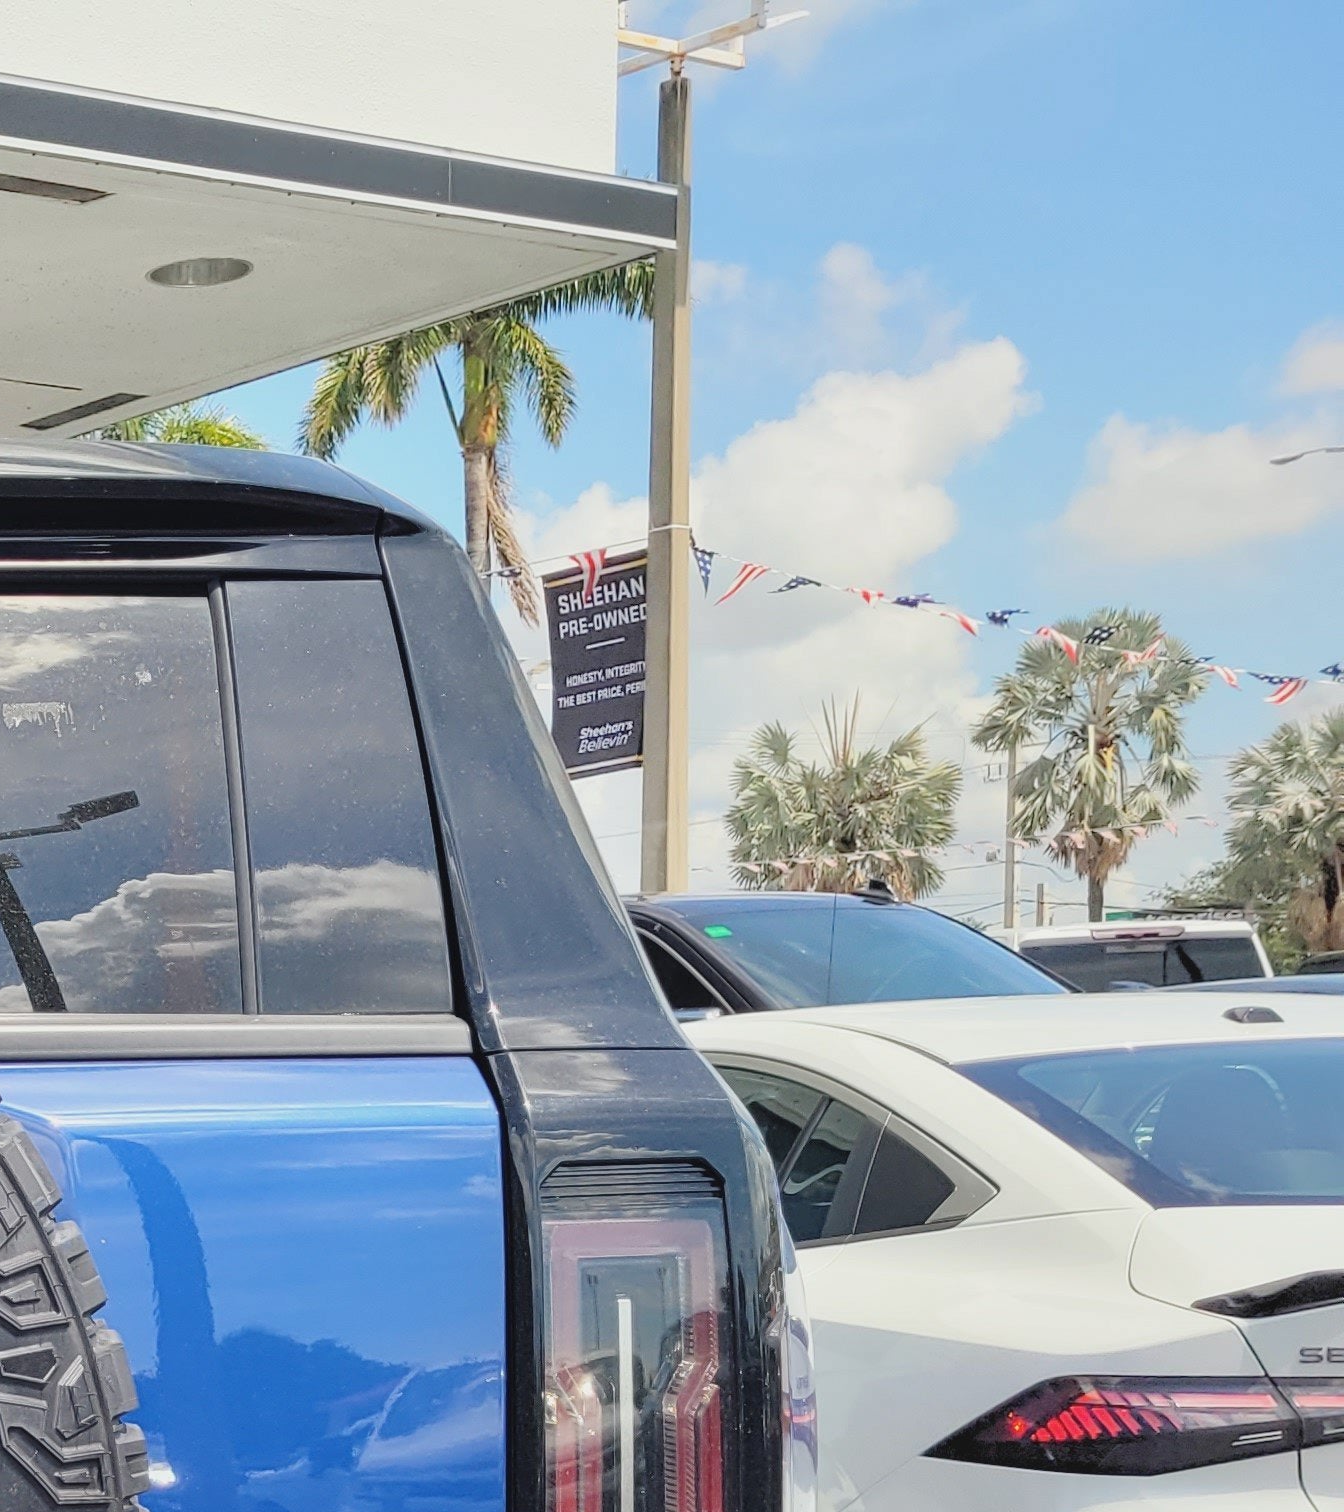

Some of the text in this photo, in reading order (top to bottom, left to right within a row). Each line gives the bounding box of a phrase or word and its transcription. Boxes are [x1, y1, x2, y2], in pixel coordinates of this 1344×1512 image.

[558, 602, 647, 640] PRE-OWNED
[557, 695, 576, 709] THE
[576, 690, 596, 706] BEST
[577, 731, 633, 754] Believin'
